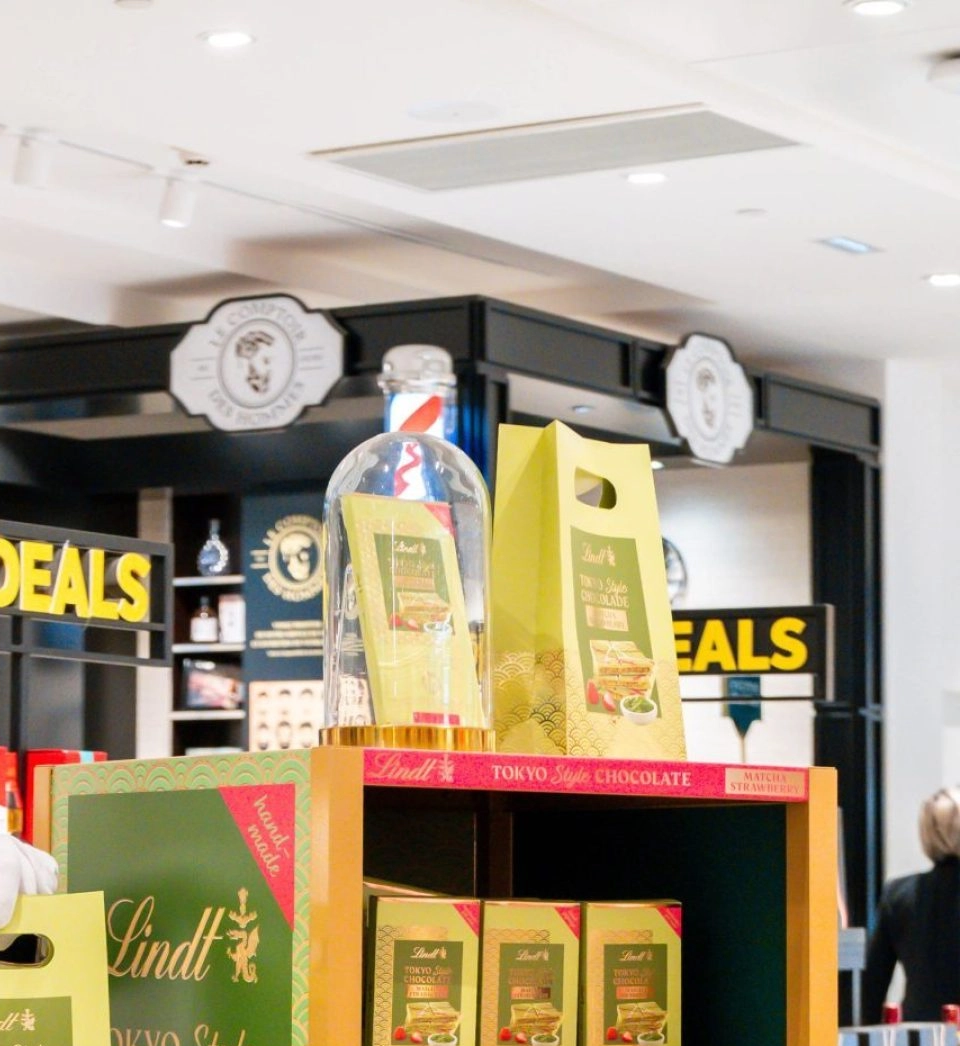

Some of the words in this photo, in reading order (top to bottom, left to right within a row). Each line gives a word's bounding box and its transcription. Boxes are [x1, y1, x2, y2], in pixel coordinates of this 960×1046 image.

[673, 617, 808, 672] EALS
[367, 753, 437, 782] Lindt
[492, 764, 547, 781] TOKYO
[550, 764, 590, 787] Style
[594, 768, 691, 787] CHOCOLATE
[730, 782, 800, 794] STRAWBERRY
[743, 771, 788, 783] MATCHA
[247, 824, 281, 877] made
[108, 896, 226, 981] Lindt
